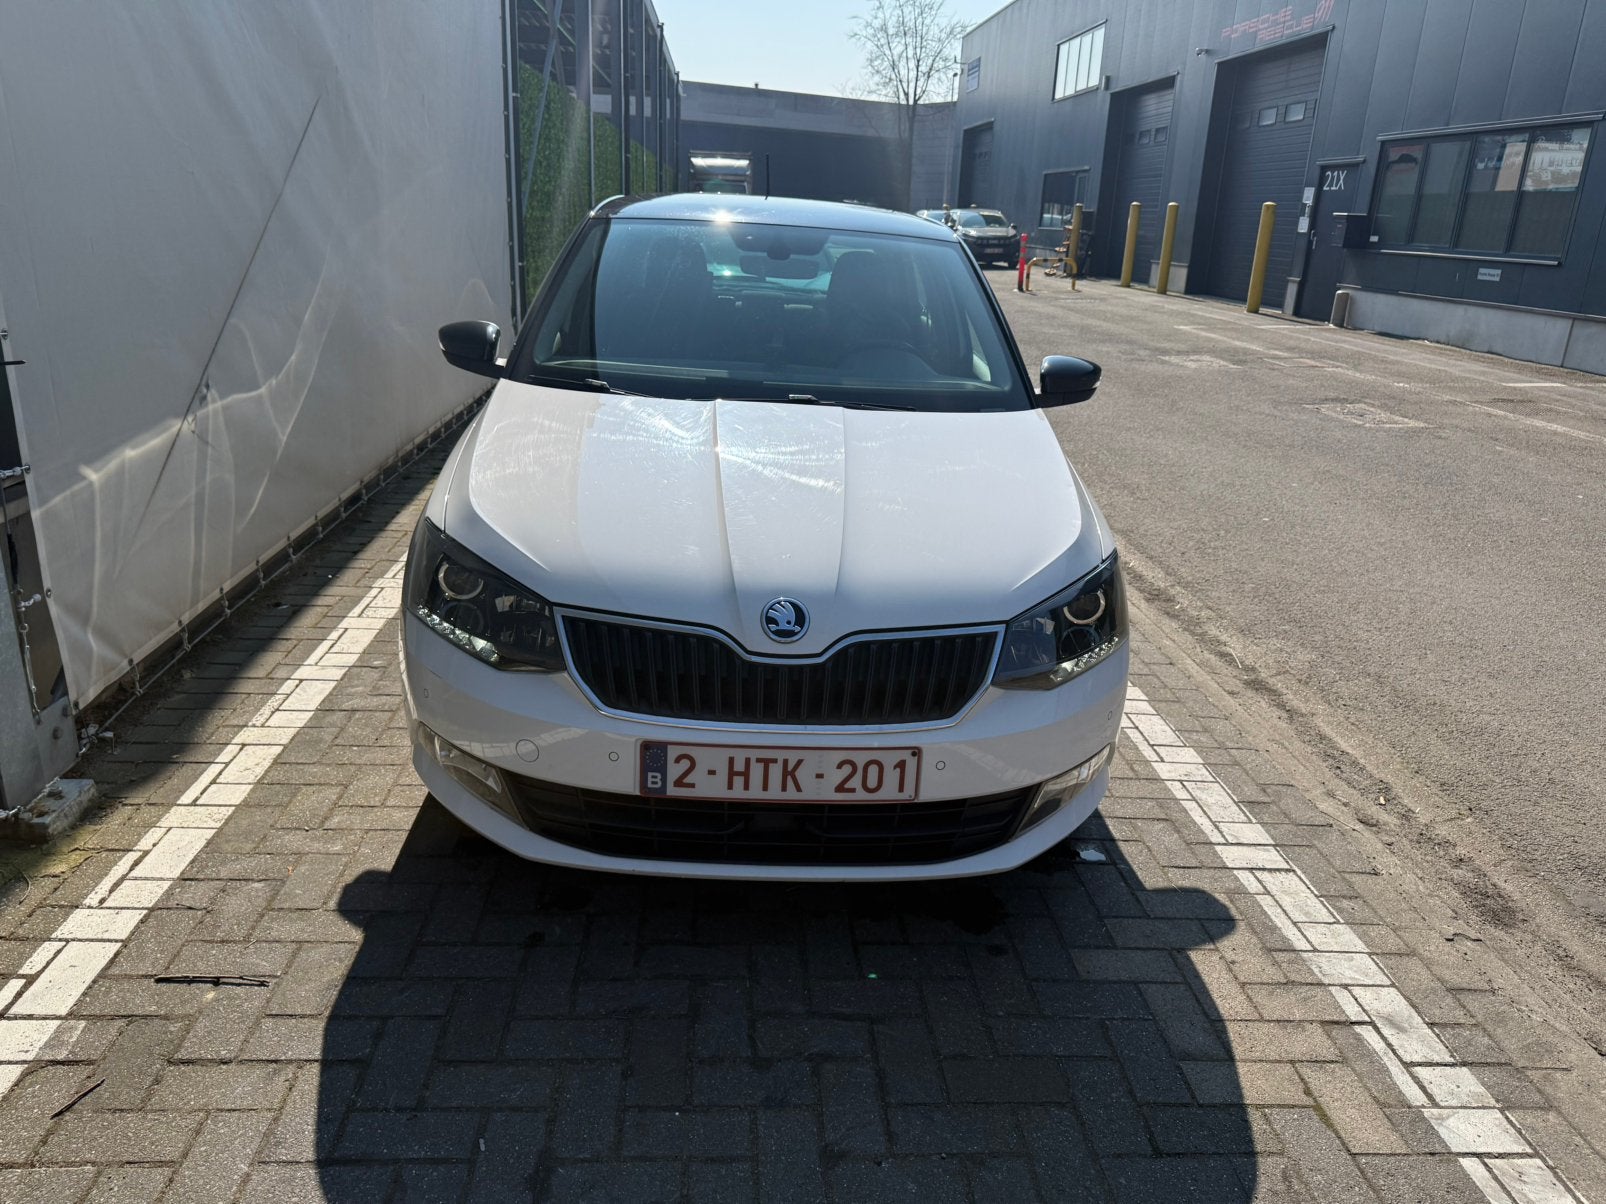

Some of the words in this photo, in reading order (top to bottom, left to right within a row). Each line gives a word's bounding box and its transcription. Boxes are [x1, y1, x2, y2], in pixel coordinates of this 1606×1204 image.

[1221, 6, 1293, 38] PORSCHE
[1258, 14, 1314, 40] RESCUE
[1323, 170, 1347, 190] 21X
[647, 771, 662, 788] B
[672, 753, 907, 794] 2-HTK-201
